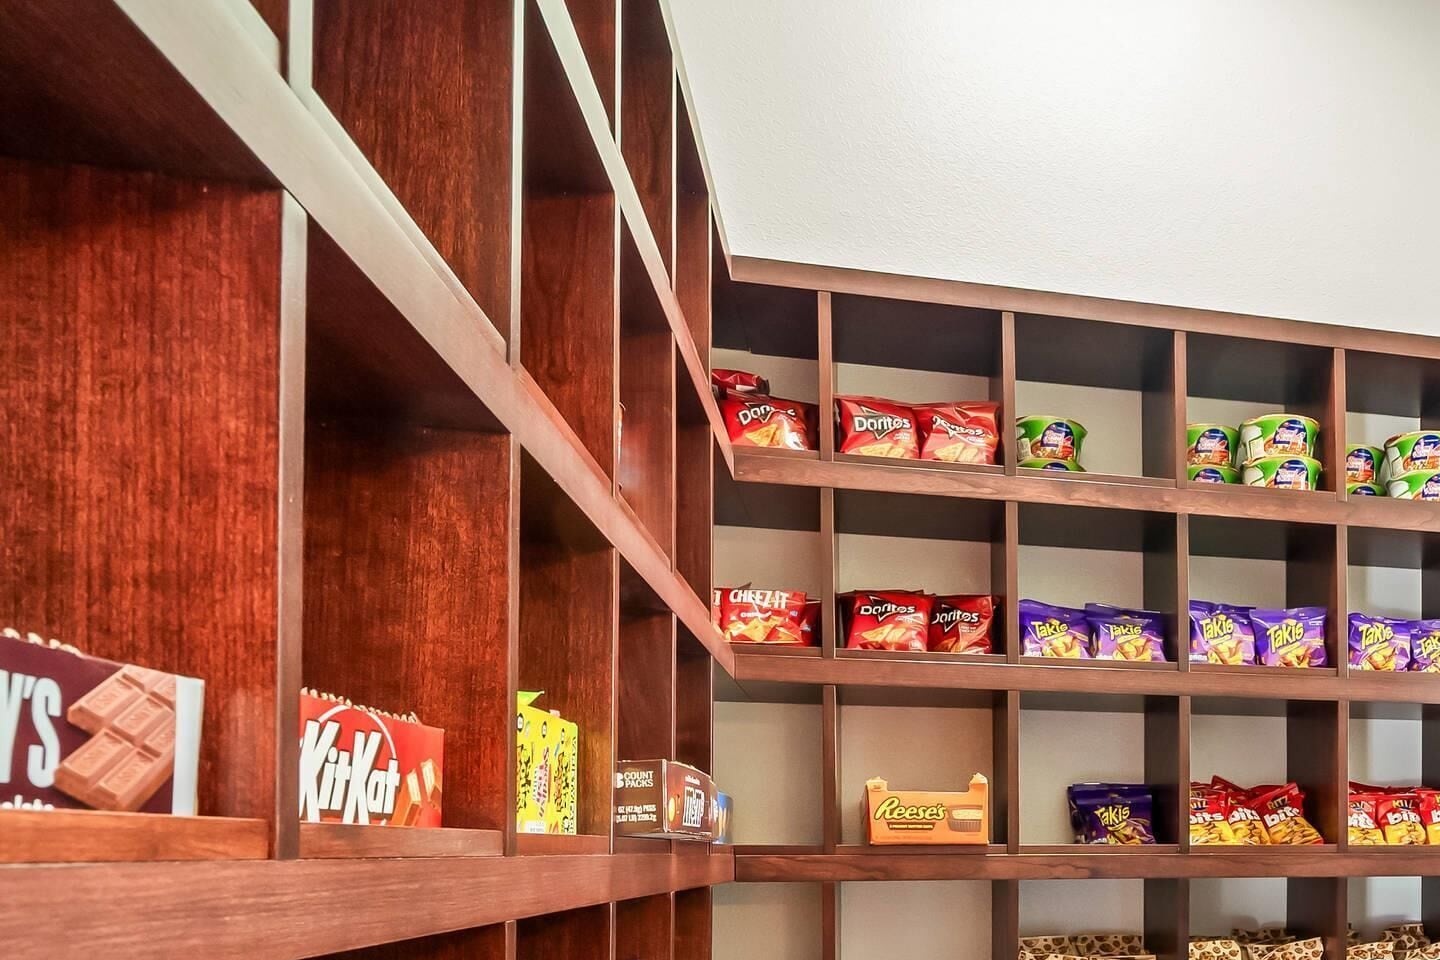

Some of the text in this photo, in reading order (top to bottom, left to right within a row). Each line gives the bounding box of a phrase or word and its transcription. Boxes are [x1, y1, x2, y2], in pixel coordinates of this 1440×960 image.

[854, 415, 912, 432] Doritos
[860, 603, 917, 615] Doritos
[1030, 621, 1069, 641] Takis
[1105, 623, 1144, 641] Takis
[1200, 617, 1234, 641] Takis
[1267, 622, 1305, 653] Takis
[1359, 622, 1394, 650] Takis
[623, 771, 654, 780] COUNT
[624, 779, 654, 788] PACKS
[1267, 795, 1290, 810] RITZ
[1094, 805, 1130, 826] Takis
